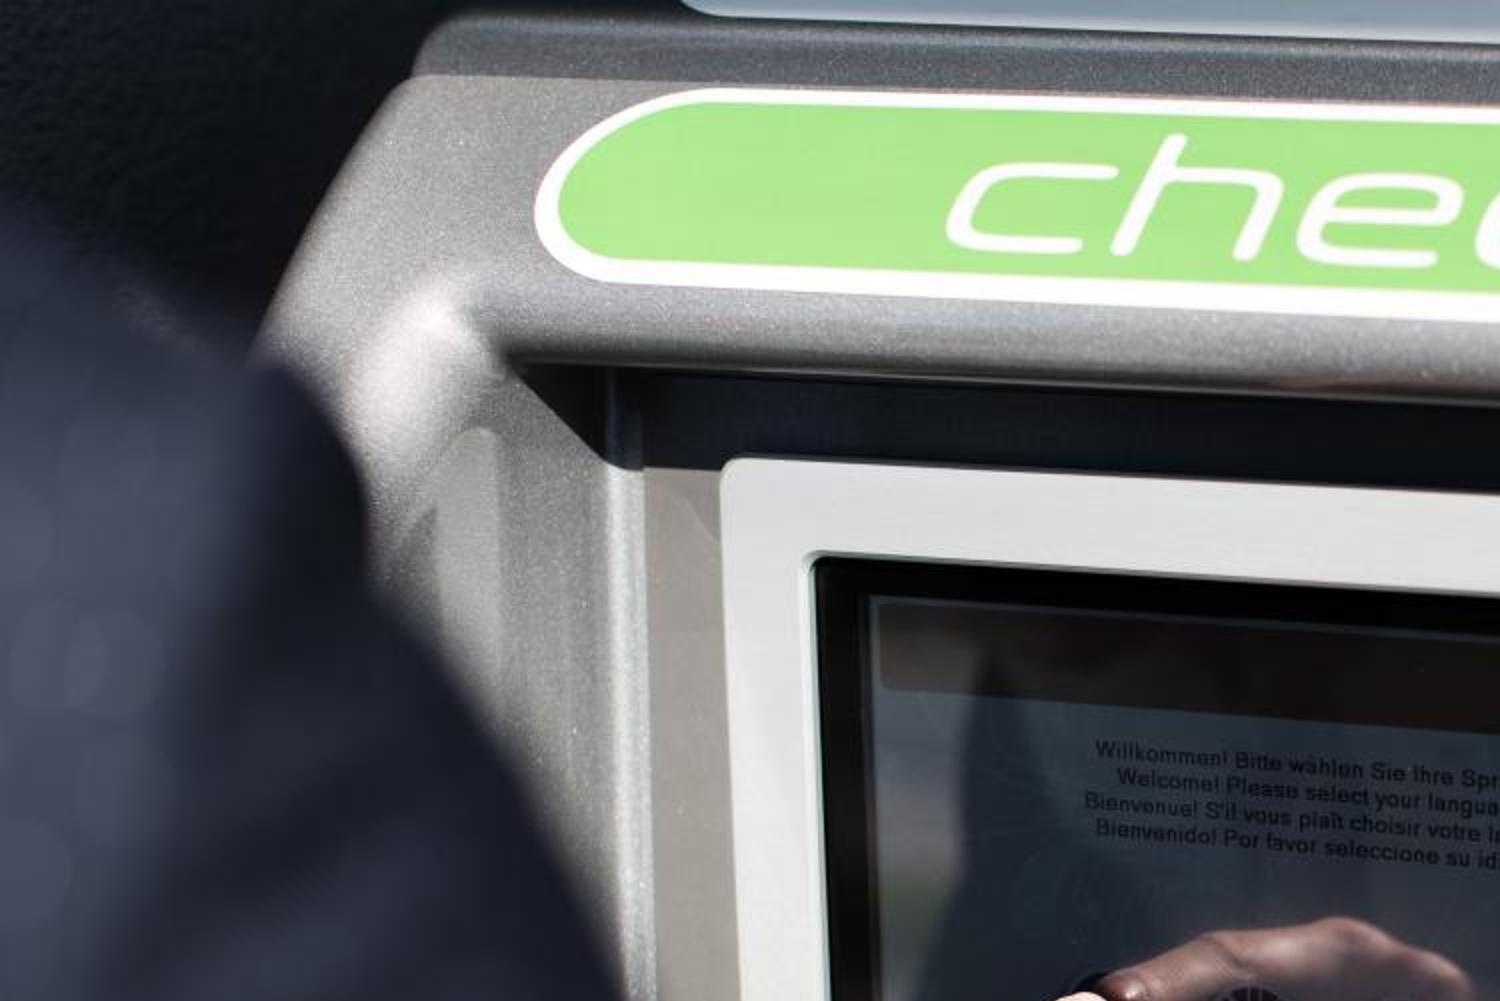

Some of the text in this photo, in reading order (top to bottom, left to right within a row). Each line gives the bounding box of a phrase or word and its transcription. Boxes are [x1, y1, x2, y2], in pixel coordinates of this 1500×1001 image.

[1095, 740, 1228, 767] Willkommen!
[1234, 751, 1283, 772] Bitte
[1287, 756, 1364, 780] wählen
[1370, 761, 1407, 783] Sie
[1412, 765, 1455, 787] Ihre
[1116, 768, 1219, 793] Welcome!
[1227, 776, 1299, 801] Please
[1306, 785, 1371, 806] select
[1376, 793, 1422, 811] your
[1085, 791, 1197, 817] Bienvenue!
[1246, 809, 1292, 827] vous
[1349, 815, 1422, 837] choisir
[1427, 823, 1481, 843] votre
[1095, 817, 1217, 845] Bienvenido!
[1223, 829, 1260, 849] Por
[1266, 833, 1317, 854] favor
[1324, 840, 1440, 866] seleccione
[1445, 854, 1470, 868] su
